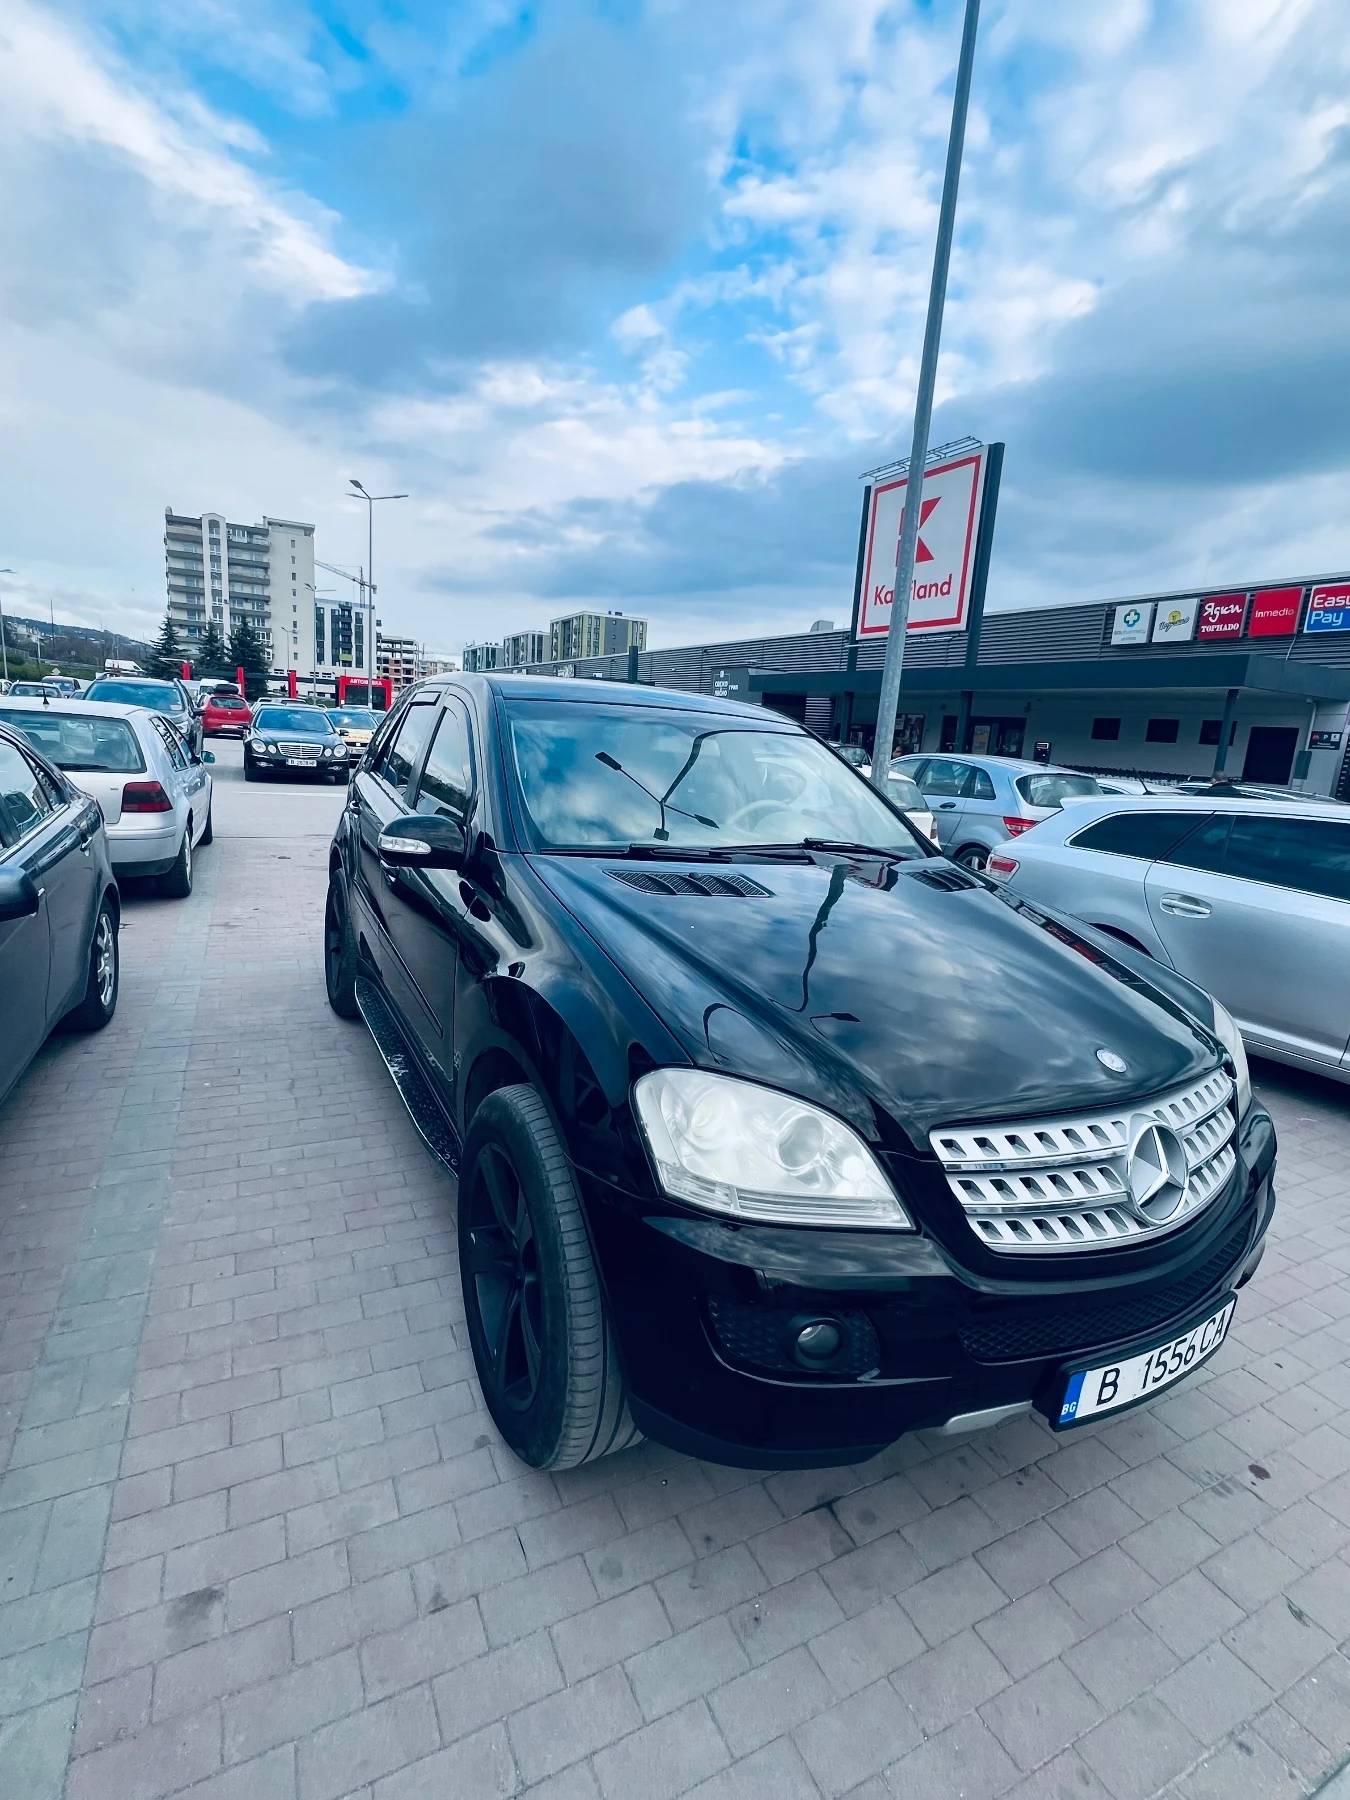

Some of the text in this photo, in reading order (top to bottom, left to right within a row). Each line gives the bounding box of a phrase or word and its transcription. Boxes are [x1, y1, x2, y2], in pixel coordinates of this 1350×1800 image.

[874, 573, 953, 606] Kaland
[1255, 608, 1295, 618] inmedio
[1310, 610, 1344, 627] Pay
[350, 678, 383, 686] АВТОМВКА
[1096, 1308, 1227, 1407] B 1556 CA
[1061, 1401, 1077, 1416] BG
